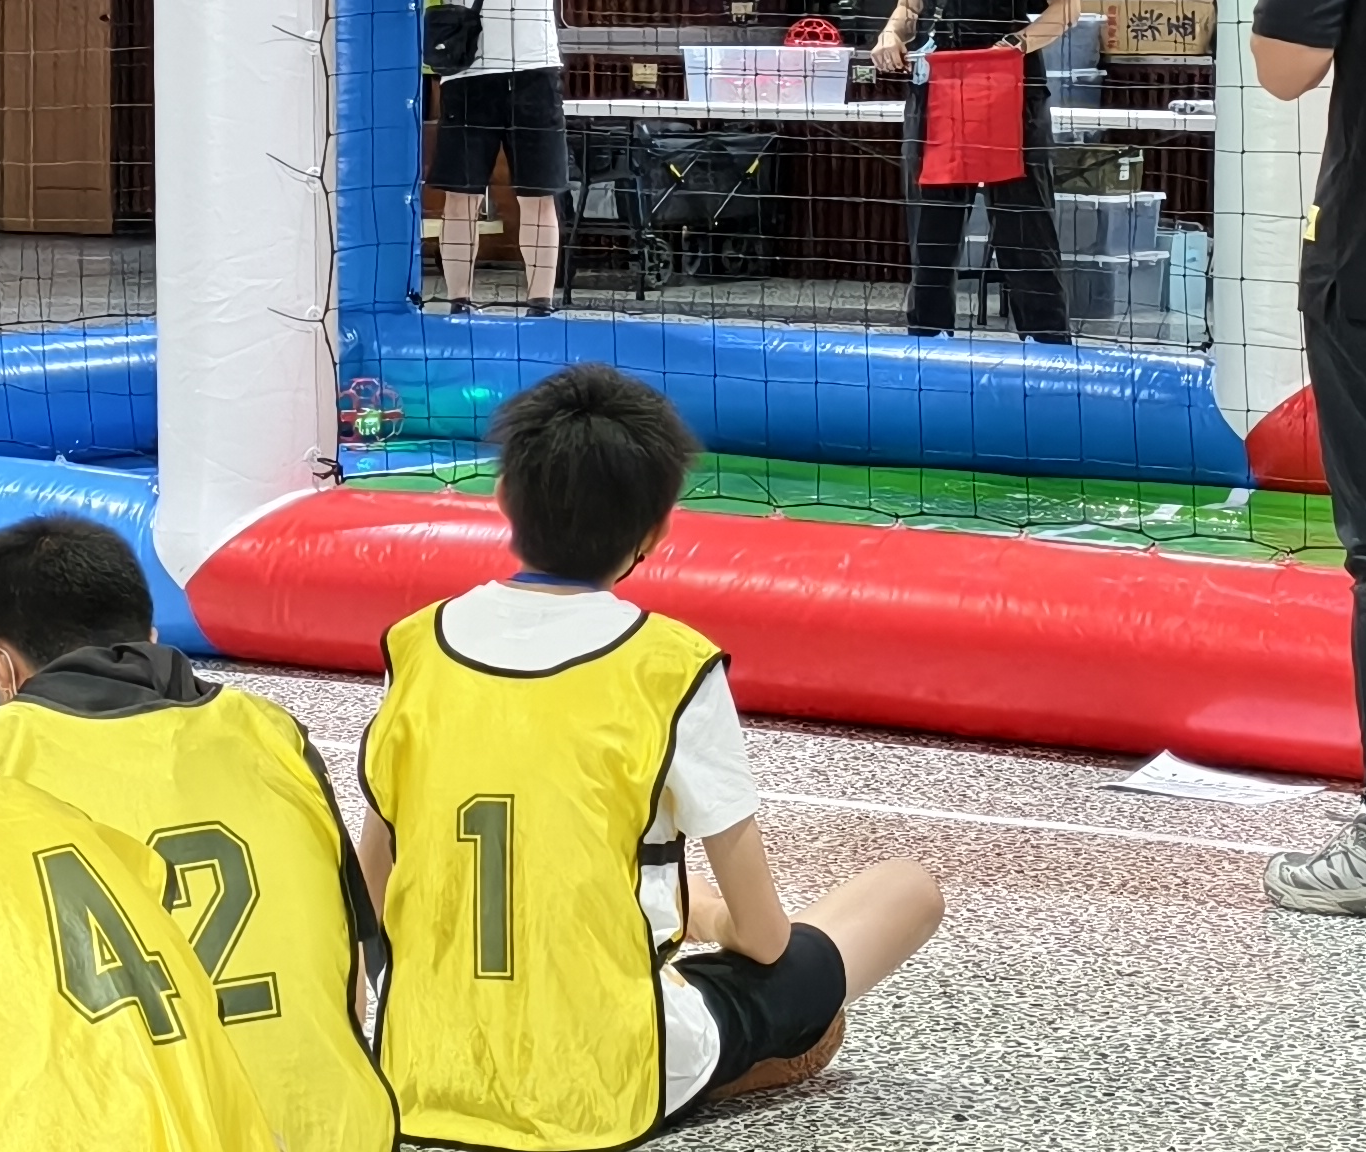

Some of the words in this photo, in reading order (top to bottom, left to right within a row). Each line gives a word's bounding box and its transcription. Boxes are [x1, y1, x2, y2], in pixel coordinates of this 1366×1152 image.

[31, 842, 187, 1046] 4
[146, 820, 282, 1027] 2
[457, 793, 515, 981] 1
